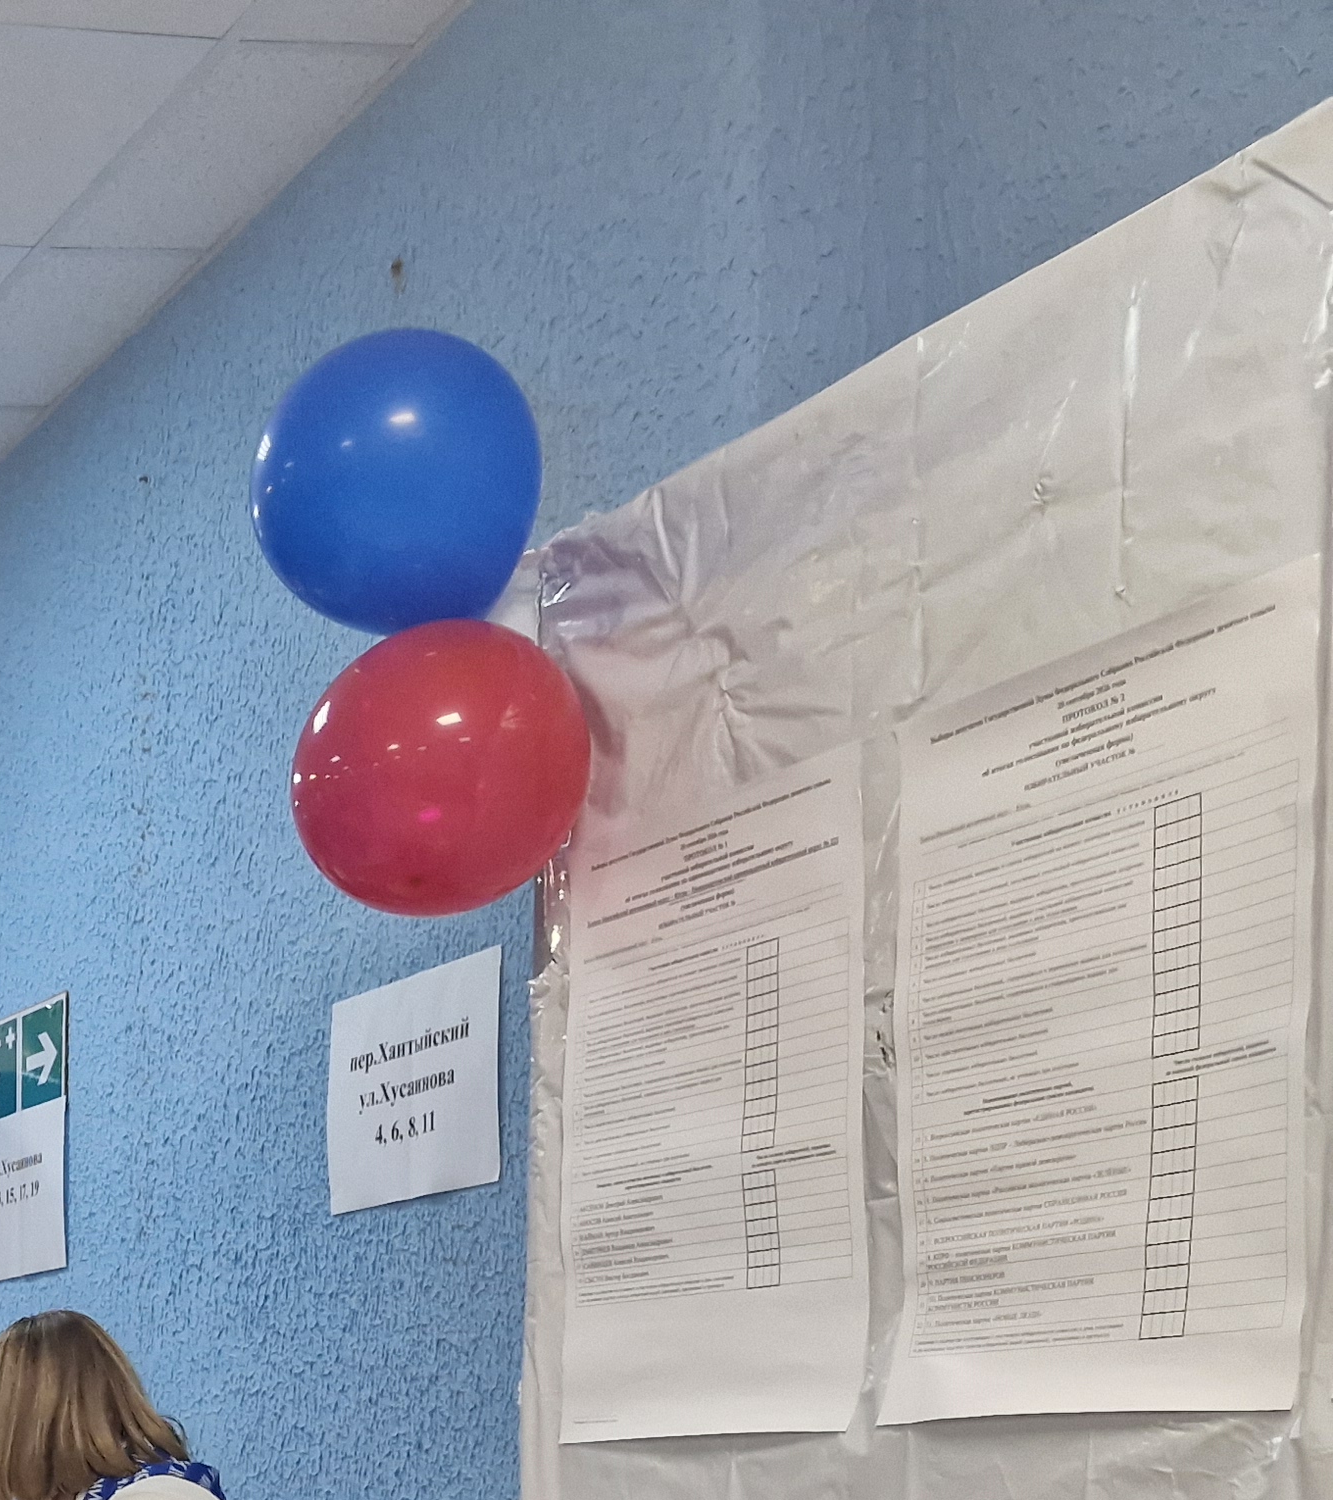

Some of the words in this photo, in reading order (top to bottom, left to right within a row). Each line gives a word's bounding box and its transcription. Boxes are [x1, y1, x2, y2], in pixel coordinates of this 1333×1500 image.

[350, 1017, 469, 1073] пер.Хантыйский
[391, 1119, 403, 1143] 6,
[422, 1110, 436, 1133] 11
